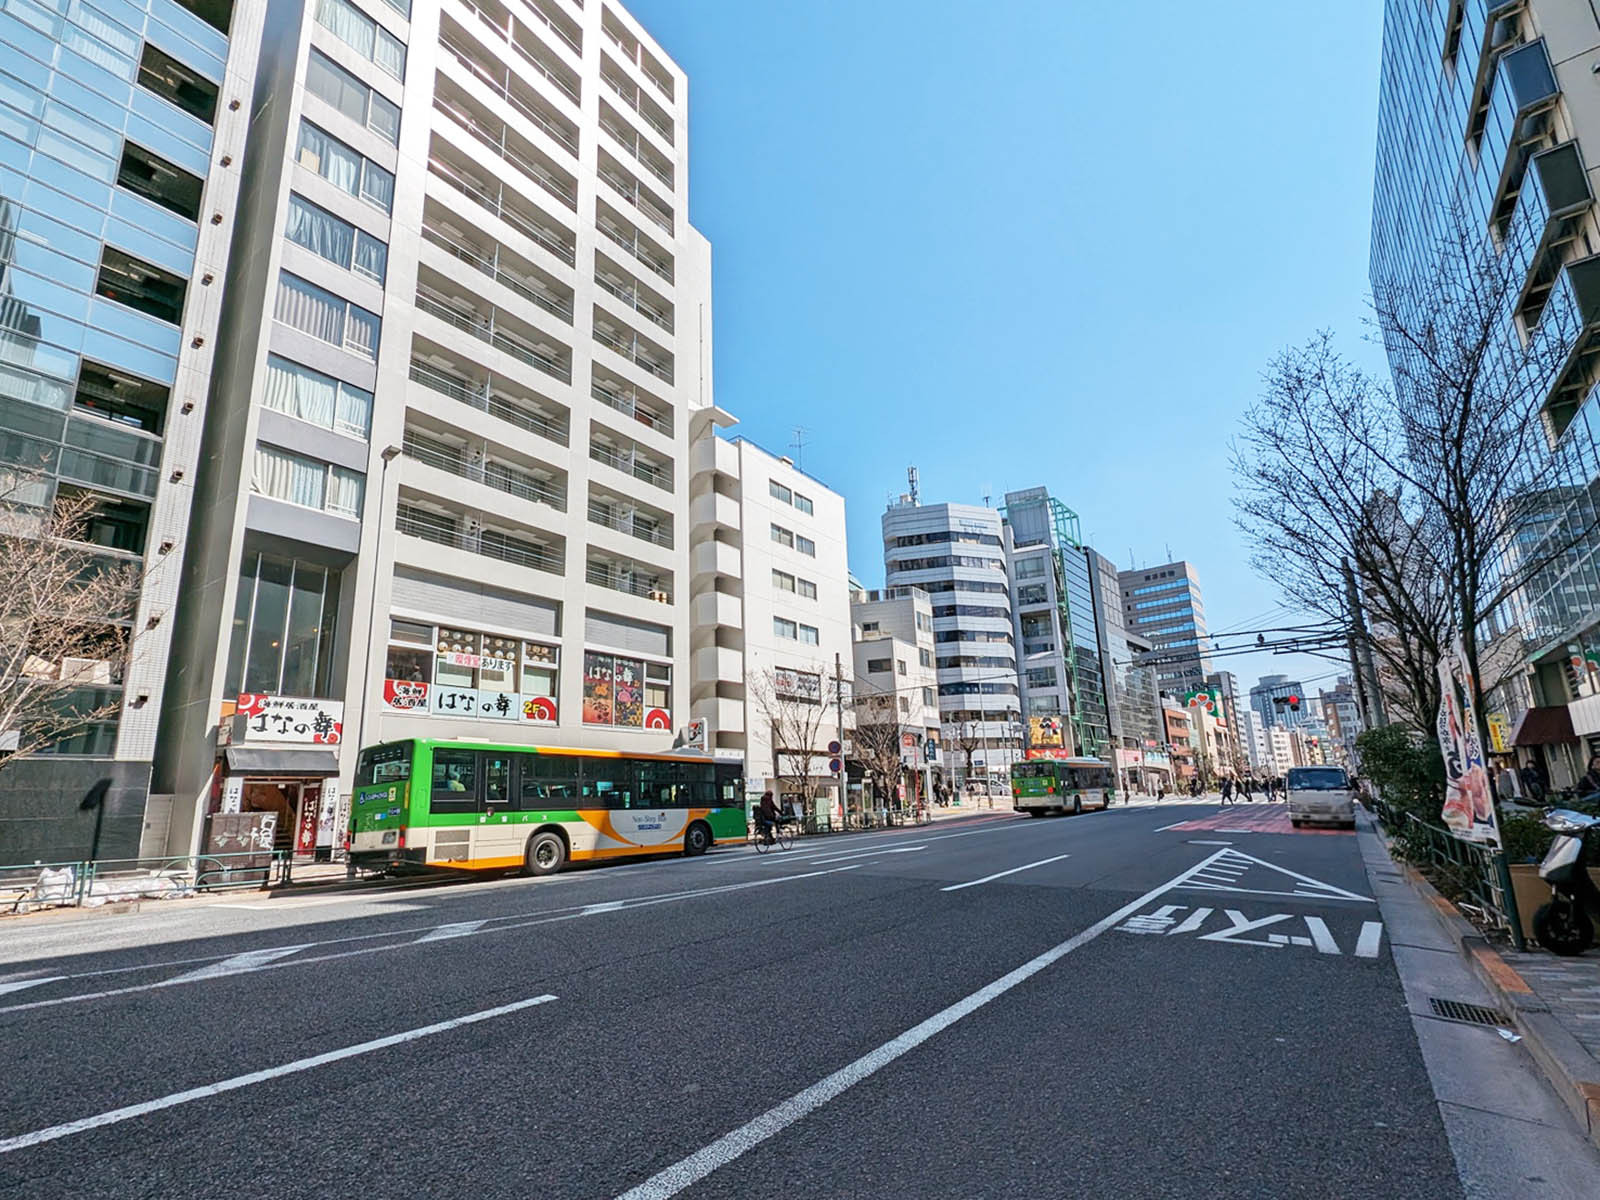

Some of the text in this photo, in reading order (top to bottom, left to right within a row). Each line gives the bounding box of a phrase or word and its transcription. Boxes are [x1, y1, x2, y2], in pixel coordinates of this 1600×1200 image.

[438, 693, 512, 717] はなの舞
[523, 701, 541, 714] 2F
